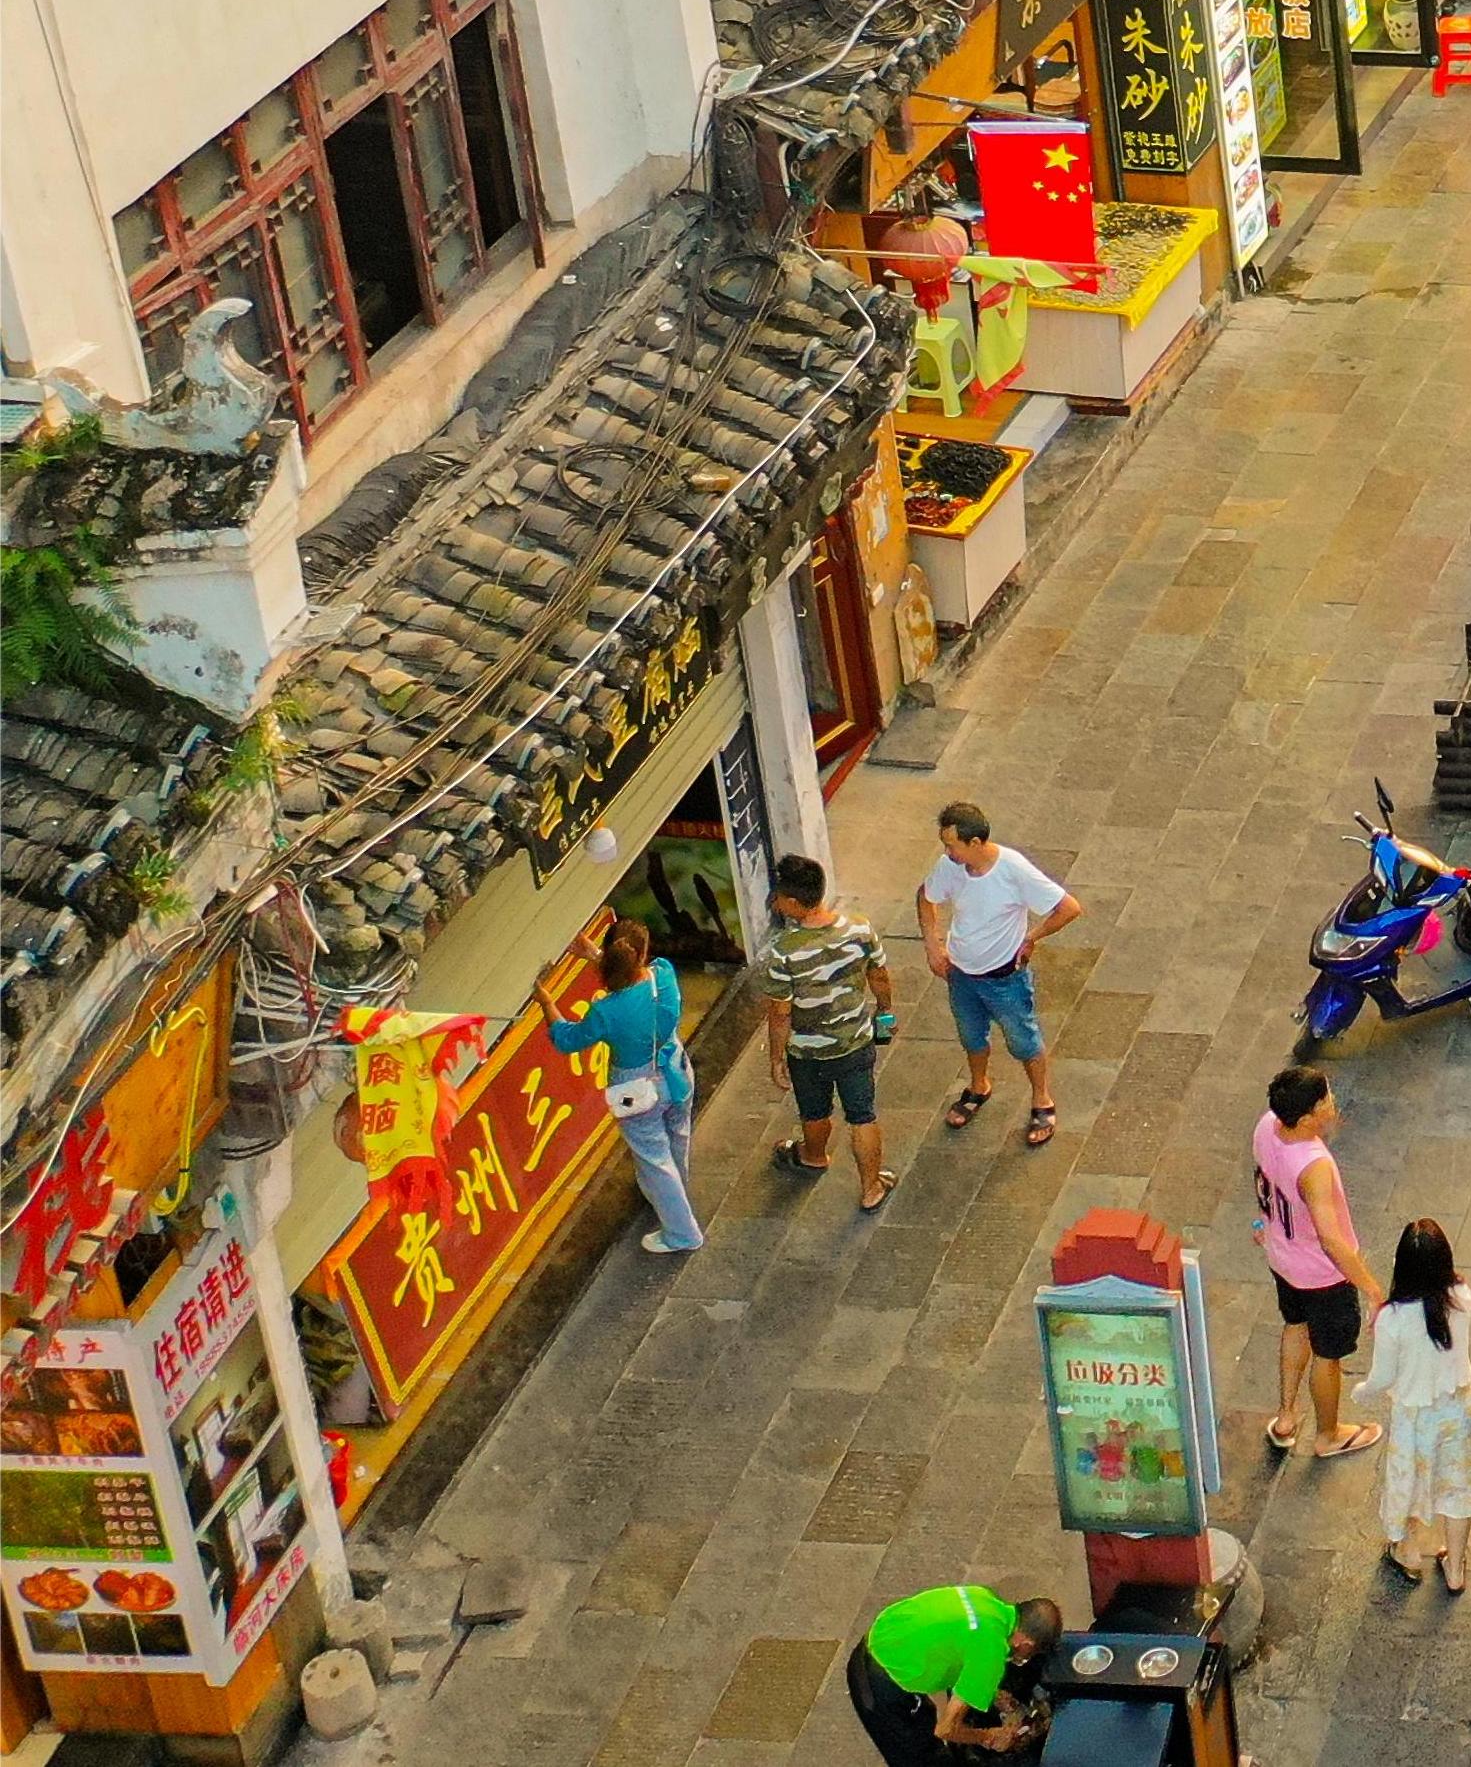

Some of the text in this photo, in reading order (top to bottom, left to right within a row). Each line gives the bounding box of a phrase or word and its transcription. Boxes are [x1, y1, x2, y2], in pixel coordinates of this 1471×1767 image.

[1120, 7, 1170, 121] 朱砂
[1179, 10, 1209, 145] 朱砂
[153, 1236, 252, 1394] 住宿请进
[1066, 1358, 1166, 1387] 垃圾分类
